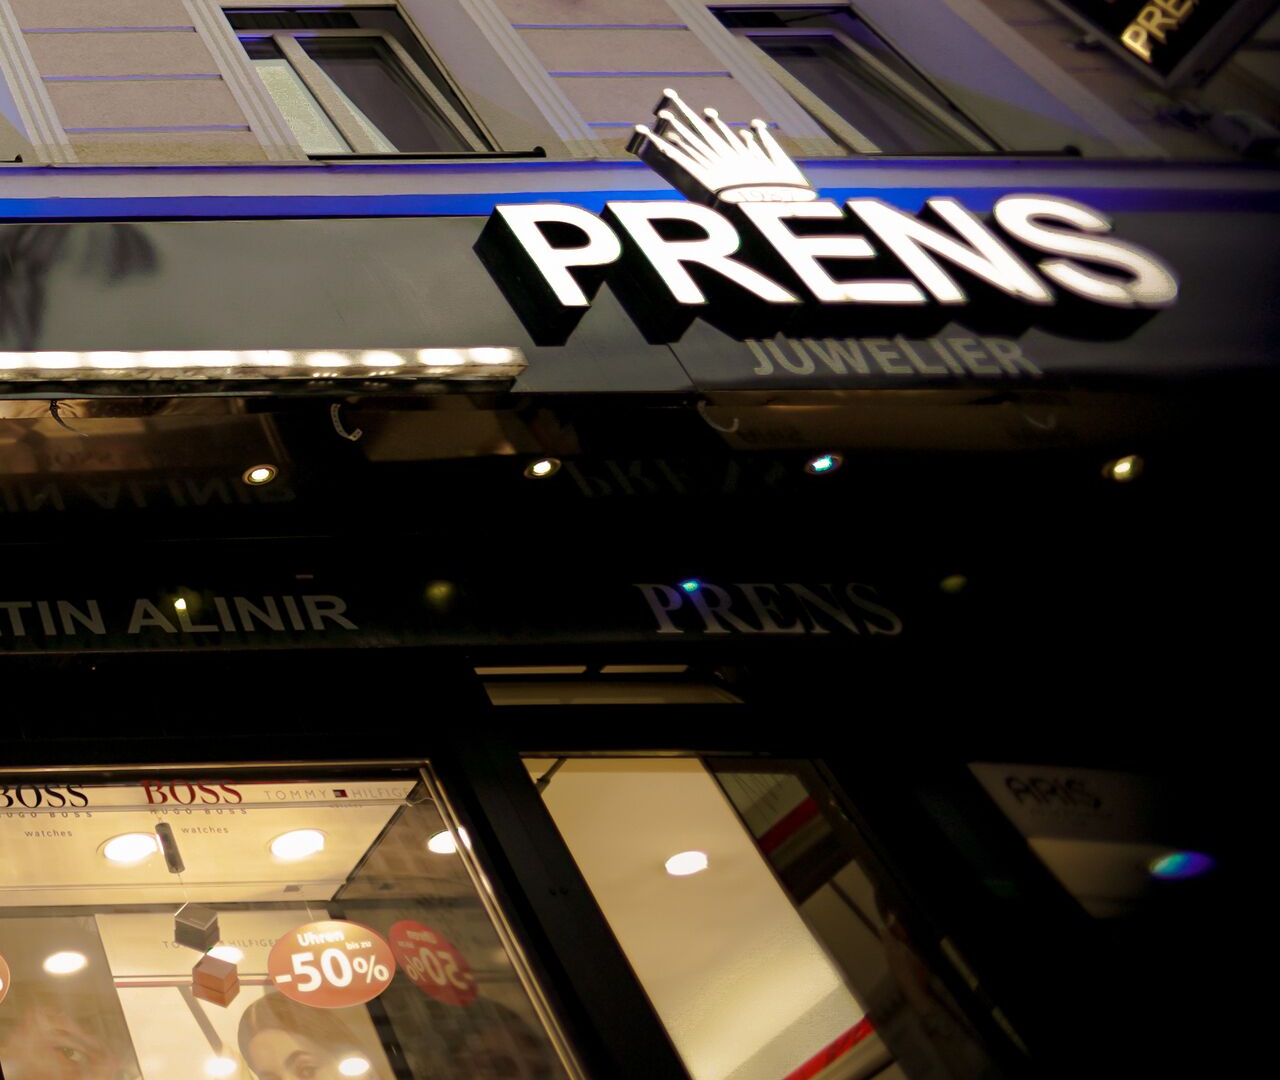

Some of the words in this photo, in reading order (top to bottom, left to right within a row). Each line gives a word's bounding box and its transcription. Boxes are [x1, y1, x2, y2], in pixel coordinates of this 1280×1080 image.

[495, 194, 1180, 308] PRENS
[127, 594, 359, 635] ALINIR
[634, 581, 904, 636] PRENS
[142, 779, 243, 805] BOSS
[263, 789, 329, 801] TOMMY
[352, 787, 409, 799] HILFIGE
[49, 810, 93, 818] BOSS
[204, 807, 248, 815] BOSS
[24, 829, 73, 837] watches
[180, 825, 229, 834] watches
[296, 929, 345, 948] Uhren
[346, 941, 359, 951] bis
[360, 939, 373, 950] zu
[275, 946, 390, 993] -50%
